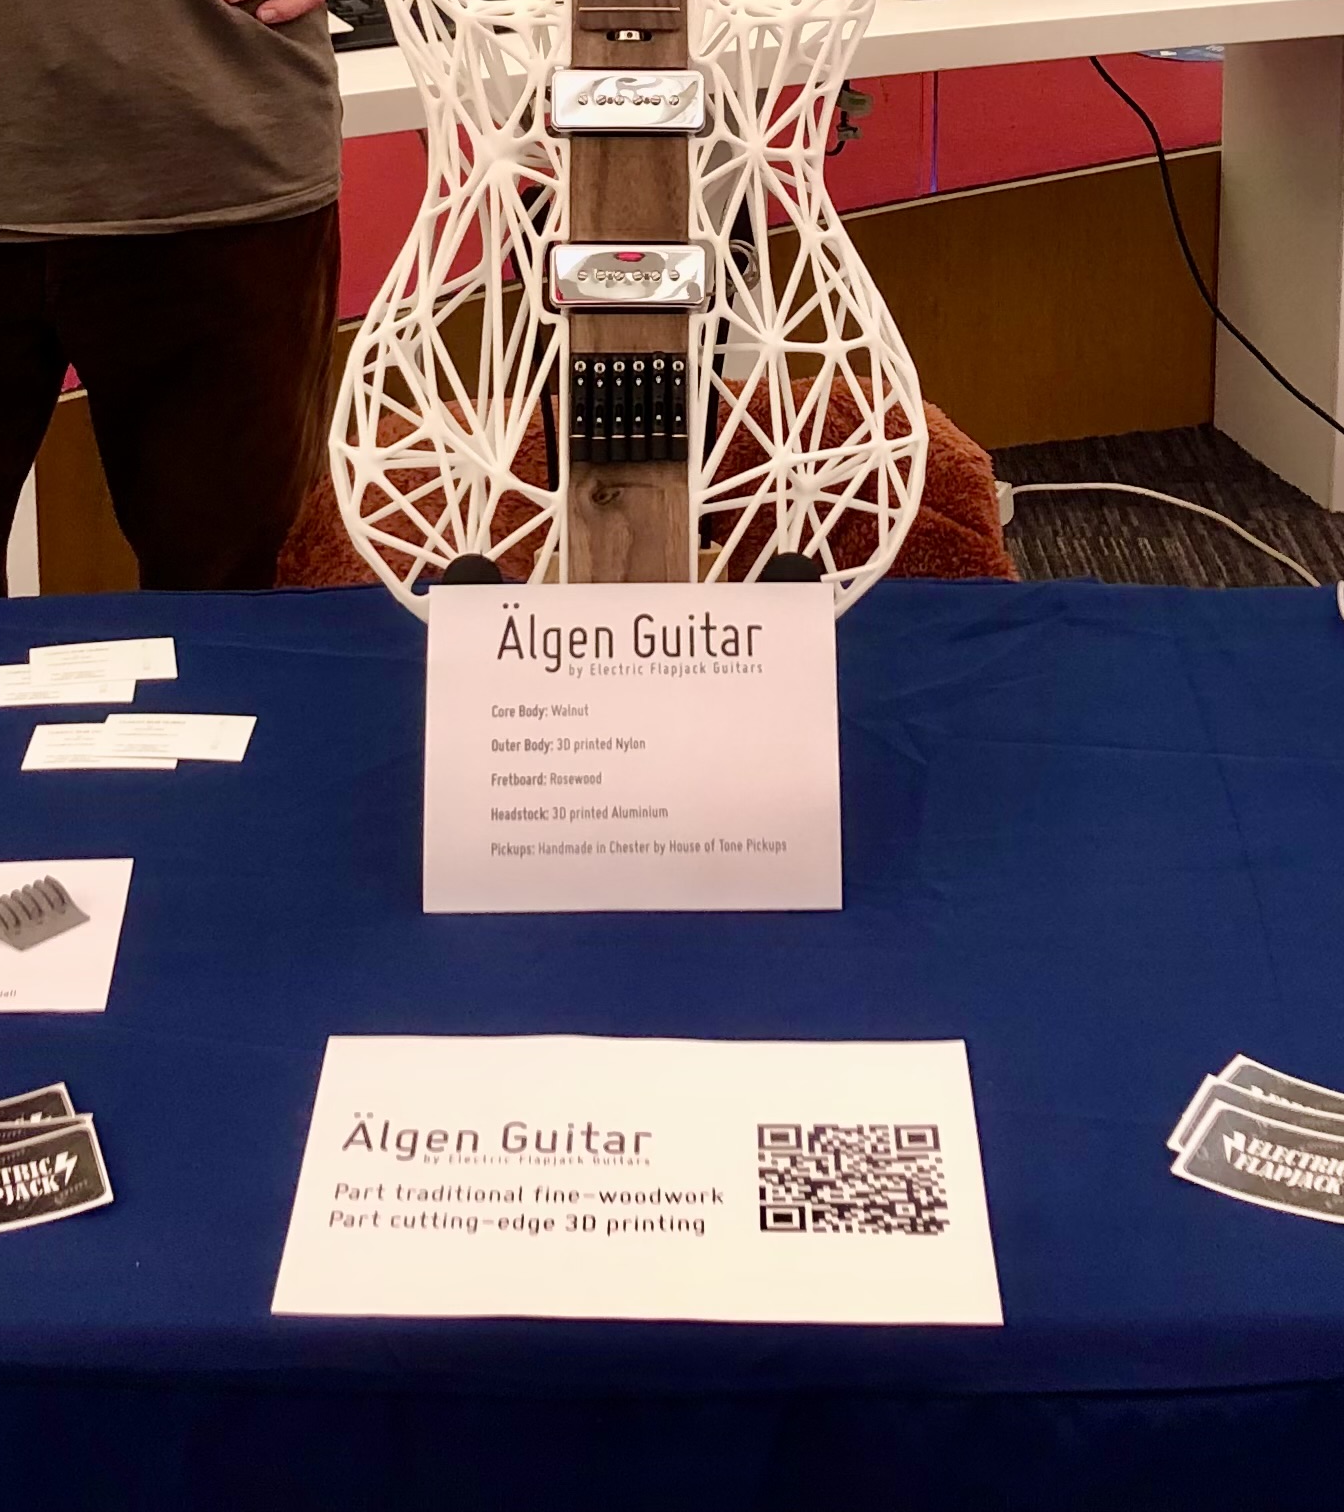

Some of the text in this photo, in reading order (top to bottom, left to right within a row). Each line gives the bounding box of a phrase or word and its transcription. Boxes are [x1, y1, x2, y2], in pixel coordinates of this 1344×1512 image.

[497, 602, 763, 673] Älgen Guitar
[568, 660, 763, 679] by Electric Flapjack Guitars
[491, 703, 590, 720] Core Body: Walnut
[491, 736, 646, 754] Outer Body: 3D printed Nylon
[491, 771, 602, 787] Fretboard: Rosewood
[490, 804, 669, 824] Headstock: 3D printed Aluminium
[490, 835, 787, 859] Pickups: Handmade in Chester by House of Tone Pickups
[342, 1111, 653, 1162] Älgen Guitar
[1233, 1152, 1342, 1196] FLAPJACK
[333, 1182, 725, 1206] Part traditional fine-woodwork
[328, 1209, 706, 1238] Part cutting-edge 3D printing
